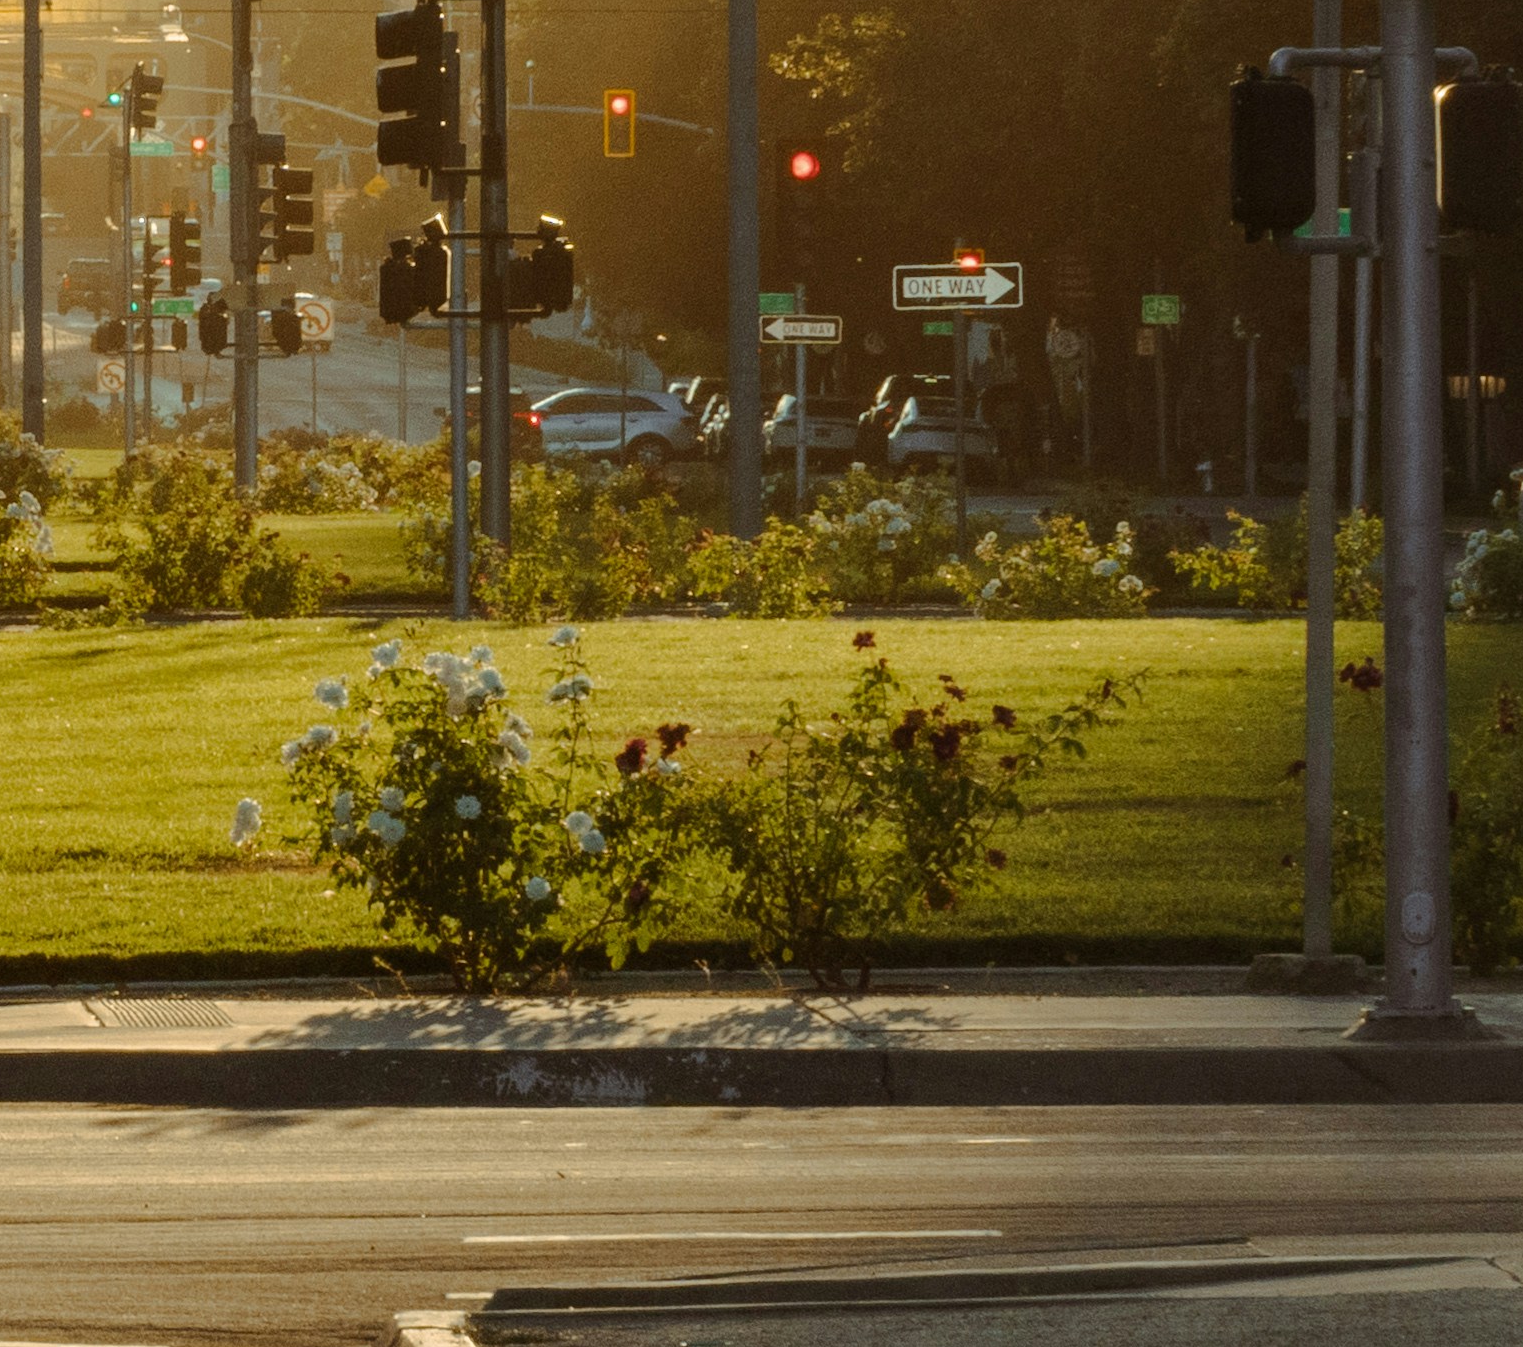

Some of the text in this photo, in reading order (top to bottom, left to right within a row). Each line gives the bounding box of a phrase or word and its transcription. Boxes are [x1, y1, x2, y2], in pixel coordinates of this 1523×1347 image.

[908, 278, 986, 296] ONE WAY
[784, 324, 832, 334] ONE WAY
